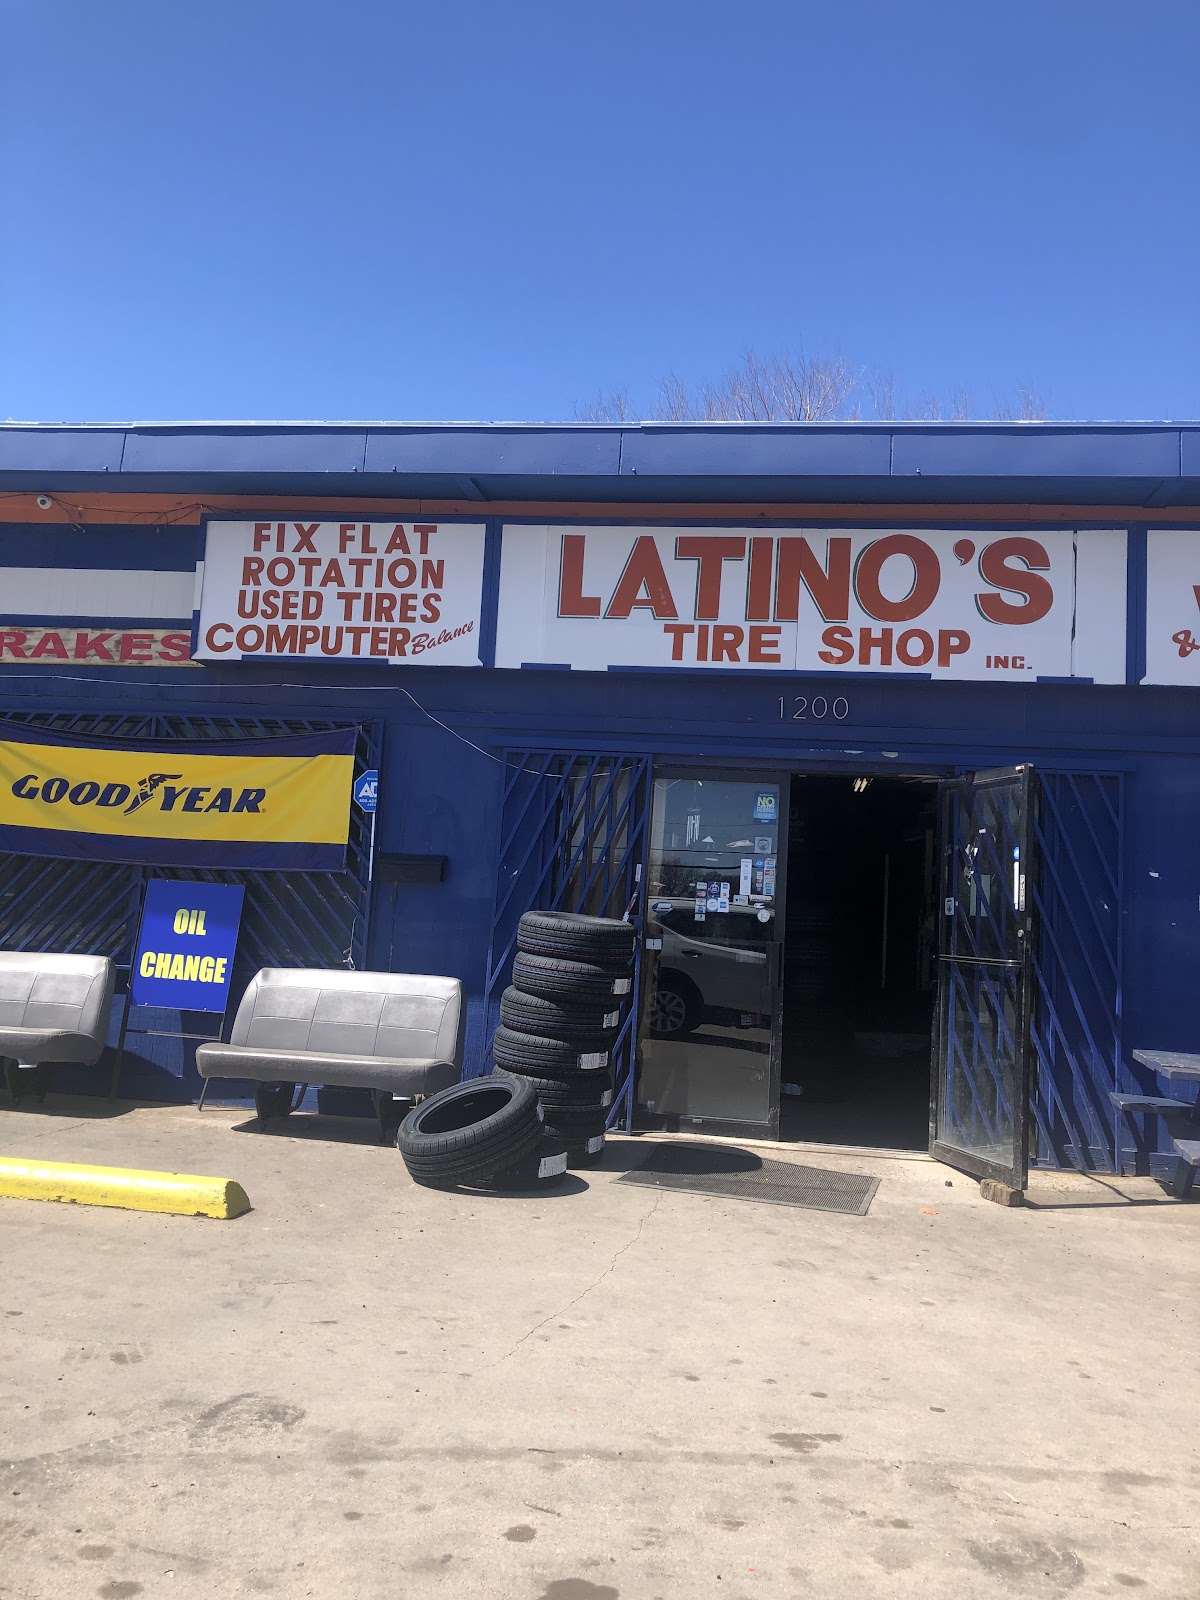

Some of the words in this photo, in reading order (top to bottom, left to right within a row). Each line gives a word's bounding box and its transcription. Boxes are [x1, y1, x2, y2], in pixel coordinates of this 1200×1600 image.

[253, 523, 320, 553] FIX
[338, 524, 437, 555] FLAT
[241, 556, 445, 589] ROTATION
[557, 533, 1054, 625] LATINO'S
[237, 590, 324, 621] USED
[337, 592, 441, 623] TIRES
[205, 622, 413, 657] COMPUTER
[411, 620, 475, 655] Balance
[663, 623, 782, 663] TIRE
[817, 626, 971, 667] SHOP
[985, 655, 1033, 670] INC.
[778, 696, 849, 720] 1200
[757, 796, 776, 806] NO
[173, 908, 207, 936] OIL
[140, 951, 228, 984] CHANGE
